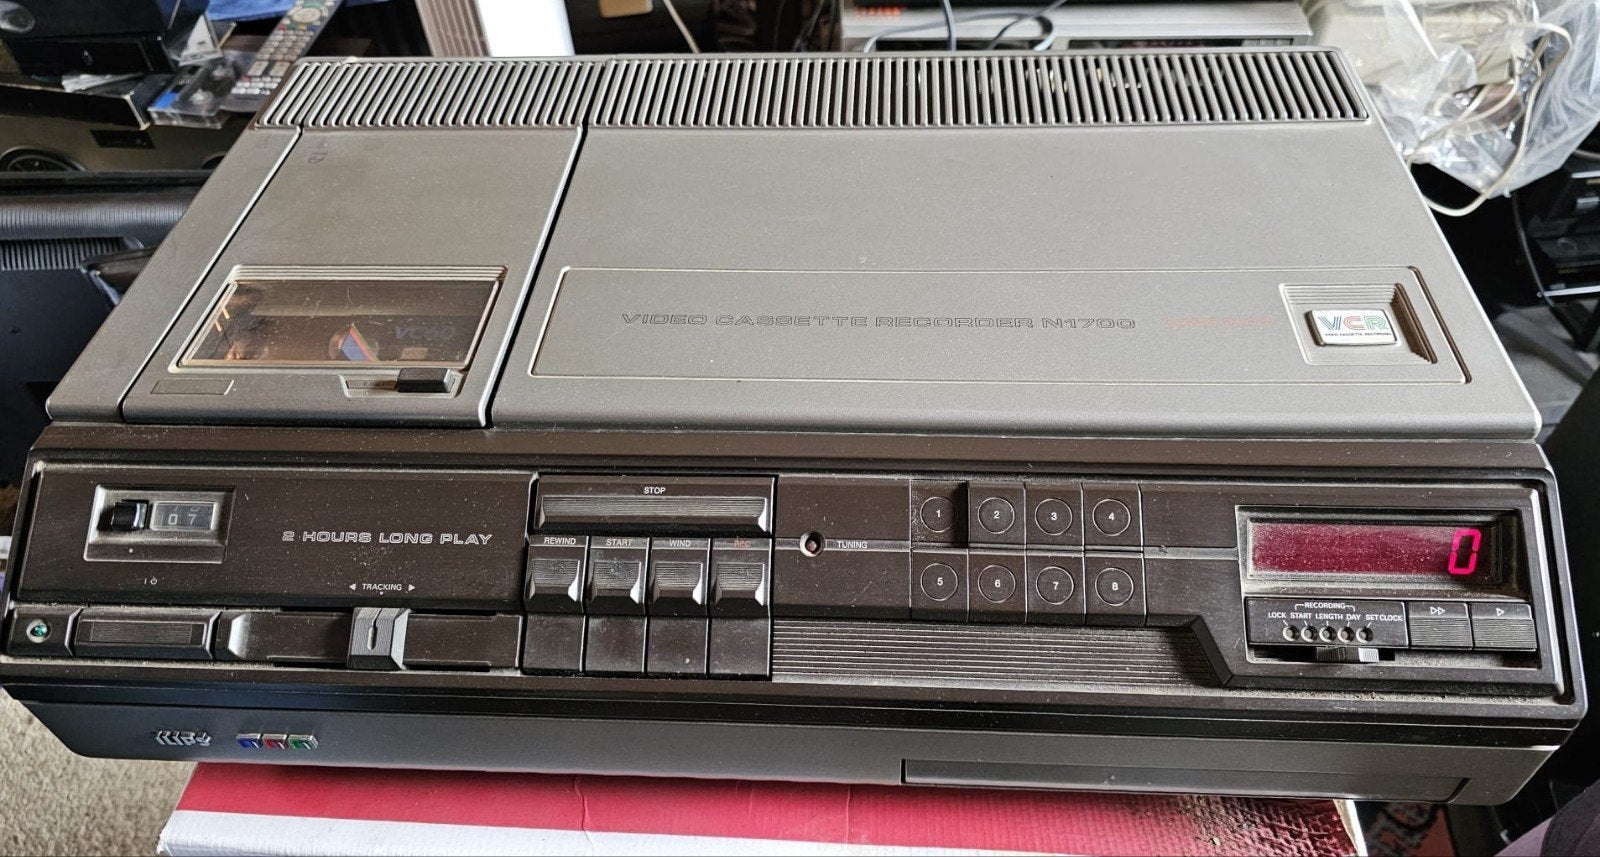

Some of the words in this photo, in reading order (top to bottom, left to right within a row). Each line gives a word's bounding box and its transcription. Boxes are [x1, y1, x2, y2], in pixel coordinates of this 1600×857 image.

[621, 313, 708, 325] VIDEO
[715, 314, 868, 327] CASSETTE
[875, 316, 1034, 328] RECORDER
[1042, 317, 1136, 329] N1700
[1318, 315, 1388, 331] VCR
[644, 486, 666, 495] STOP
[936, 509, 941, 518] 1
[993, 510, 1000, 519] 2
[1050, 511, 1058, 521] 3
[1107, 512, 1115, 521] 4
[282, 530, 296, 542] 2
[302, 531, 372, 543] HOURS
[379, 532, 433, 544] LONG
[440, 533, 493, 545] PLAY
[543, 537, 577, 546] REWIND
[606, 538, 633, 547] START
[669, 539, 692, 548] WIND
[733, 540, 751, 549] REC
[837, 540, 868, 549] TUNING
[1447, 528, 1482, 575] 0
[936, 577, 944, 586] 5
[994, 578, 1001, 588] 6
[1053, 581, 1059, 590] 7
[1111, 581, 1119, 591] 8
[362, 583, 403, 592] TRACKING
[1304, 601, 1346, 610] RECORDING
[1268, 611, 1287, 619] LOCK
[1290, 612, 1312, 620] START
[1346, 613, 1362, 621] DAY
